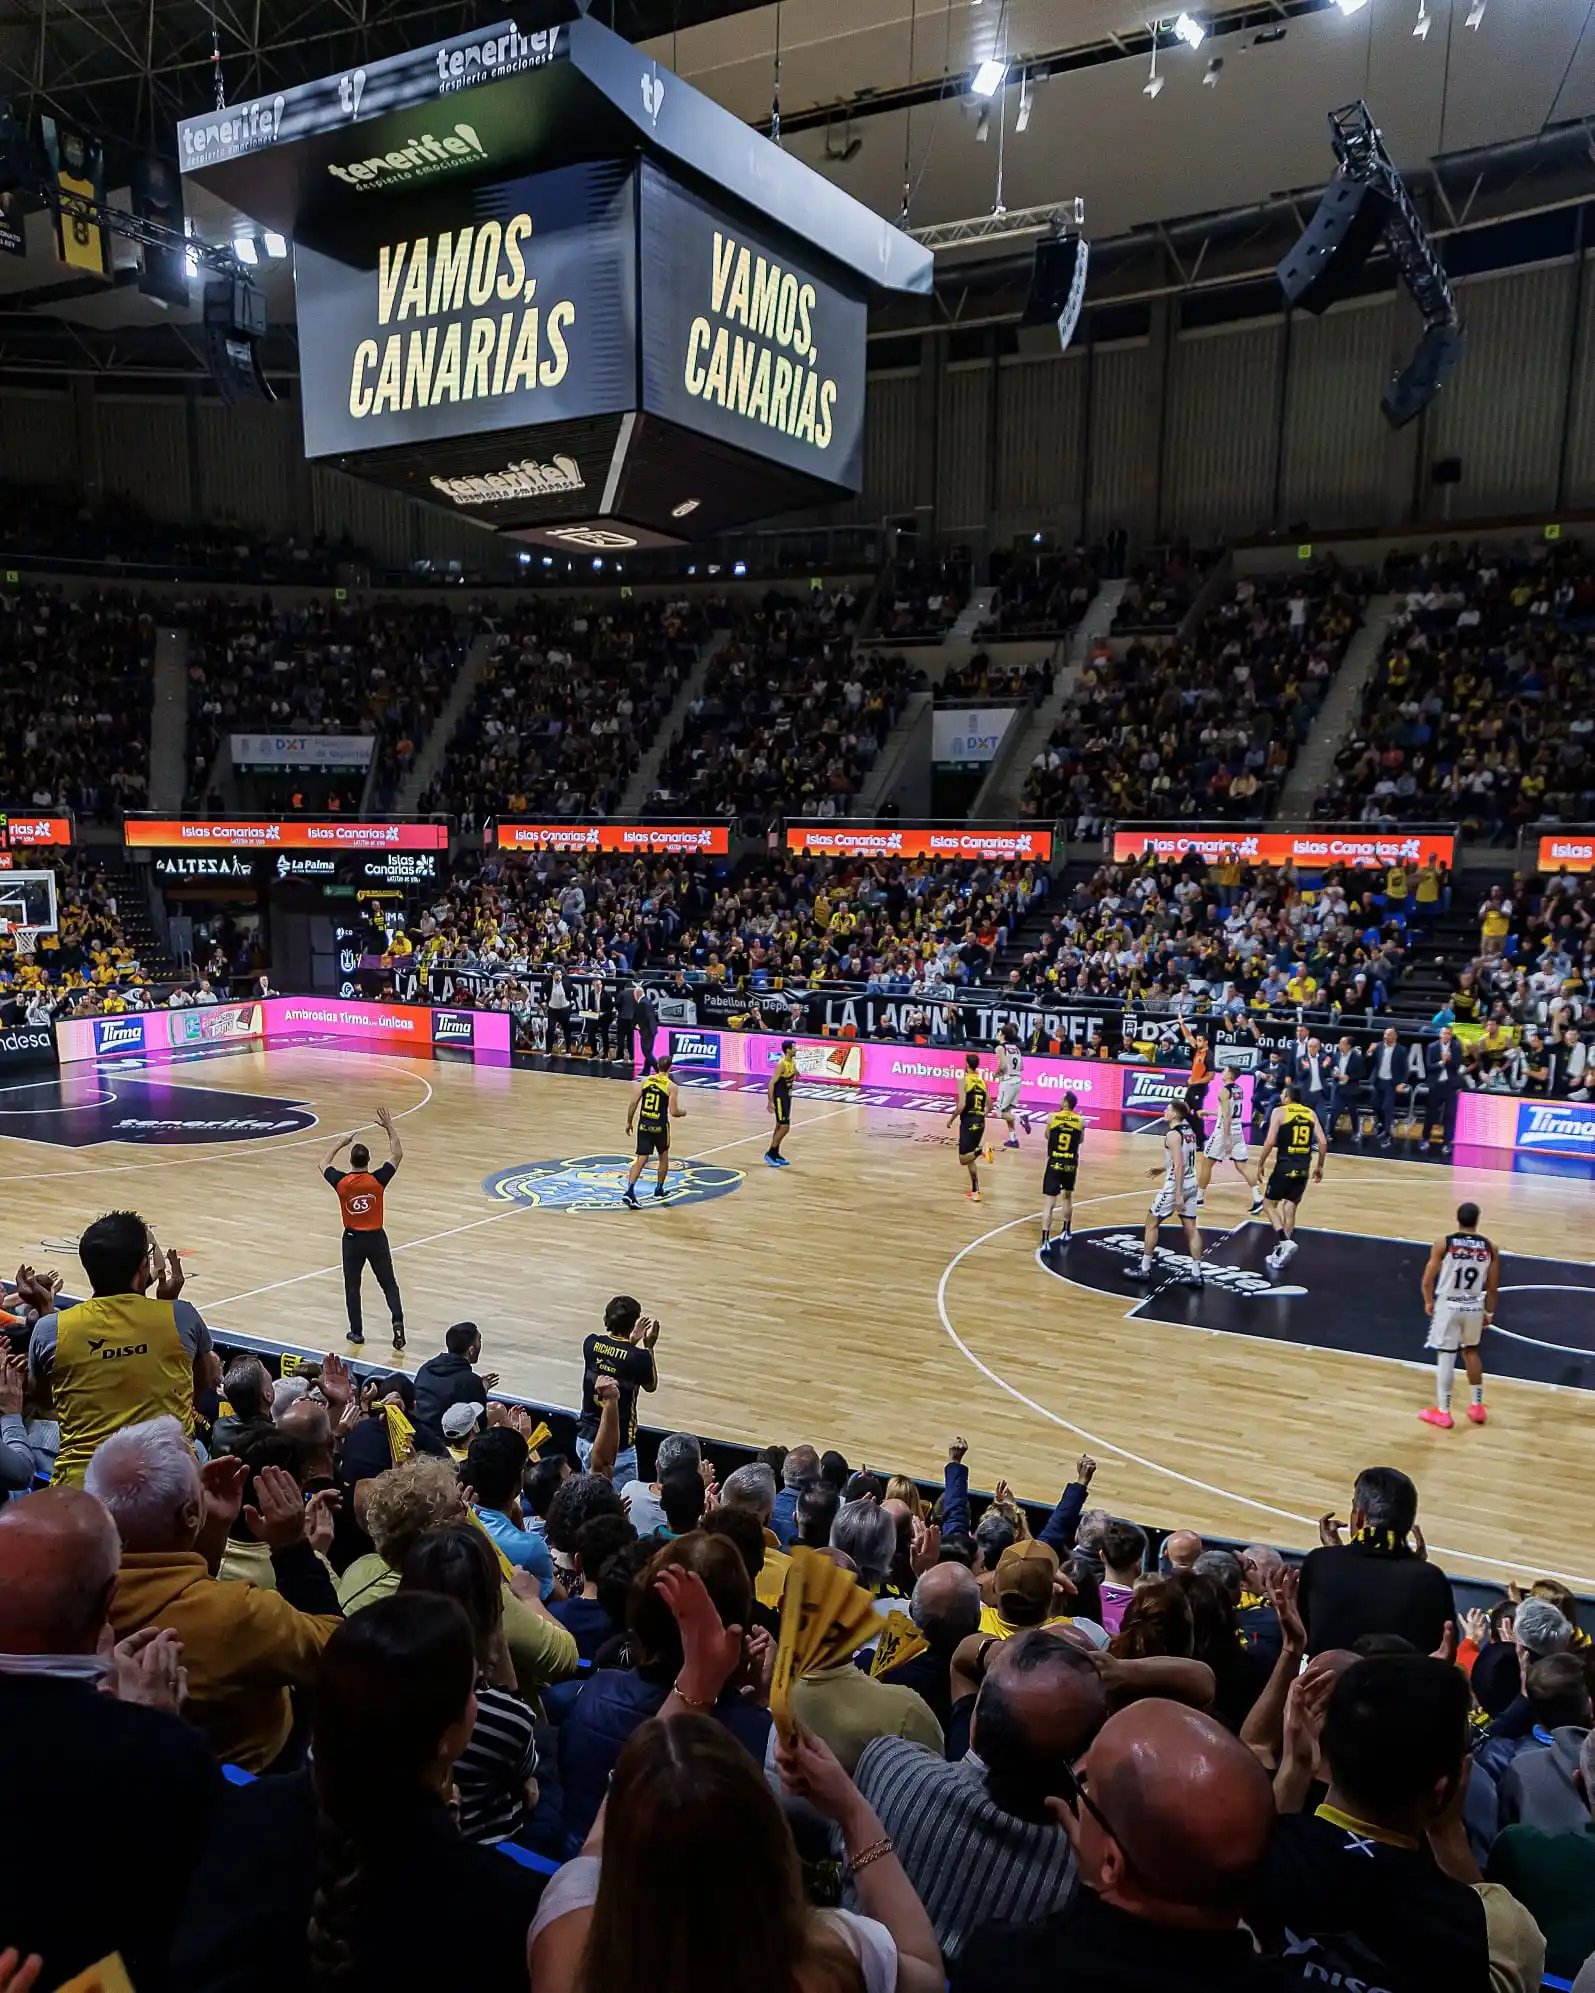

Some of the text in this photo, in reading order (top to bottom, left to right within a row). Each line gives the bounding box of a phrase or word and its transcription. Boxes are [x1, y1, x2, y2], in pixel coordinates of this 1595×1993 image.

[338, 69, 366, 121] t!
[183, 96, 285, 155] tenerife!
[327, 123, 488, 184] tenerife!
[378, 213, 537, 326] VAMOS,
[711, 231, 818, 366] VAMOS,
[349, 300, 576, 418] CANARIAS
[684, 316, 837, 449] CANARIAS
[276, 738, 307, 750] DXT
[967, 736, 999, 749] DXT
[182, 826, 265, 838] Islas Canarias
[307, 827, 385, 839] Islas Canarias
[515, 829, 586, 842] Islas Canarias
[624, 831, 698, 843] Islas Canarias
[806, 833, 887, 847] Islas Canarias
[931, 835, 1015, 848] Islas Canarias
[1293, 840, 1328, 854] Islas
[1552, 843, 1593, 858] Islas
[292, 859, 335, 870] La Palma
[388, 854, 414, 866] Islas
[364, 864, 415, 876] Canarias
[437, 1013, 471, 1033] Tirma
[826, 1000, 857, 1028] LA
[101, 1021, 142, 1041] Tirma
[675, 1033, 717, 1054] Tirma
[1037, 1072, 1093, 1092] únicas
[1132, 1072, 1188, 1098] Tirma
[644, 1092, 660, 1111] 21
[1058, 1132, 1071, 1151] 9
[1293, 1126, 1311, 1144] 19
[353, 1199, 368, 1210] 63
[1454, 1267, 1479, 1290] 19
[594, 1342, 628, 1360] RICHOTTI
